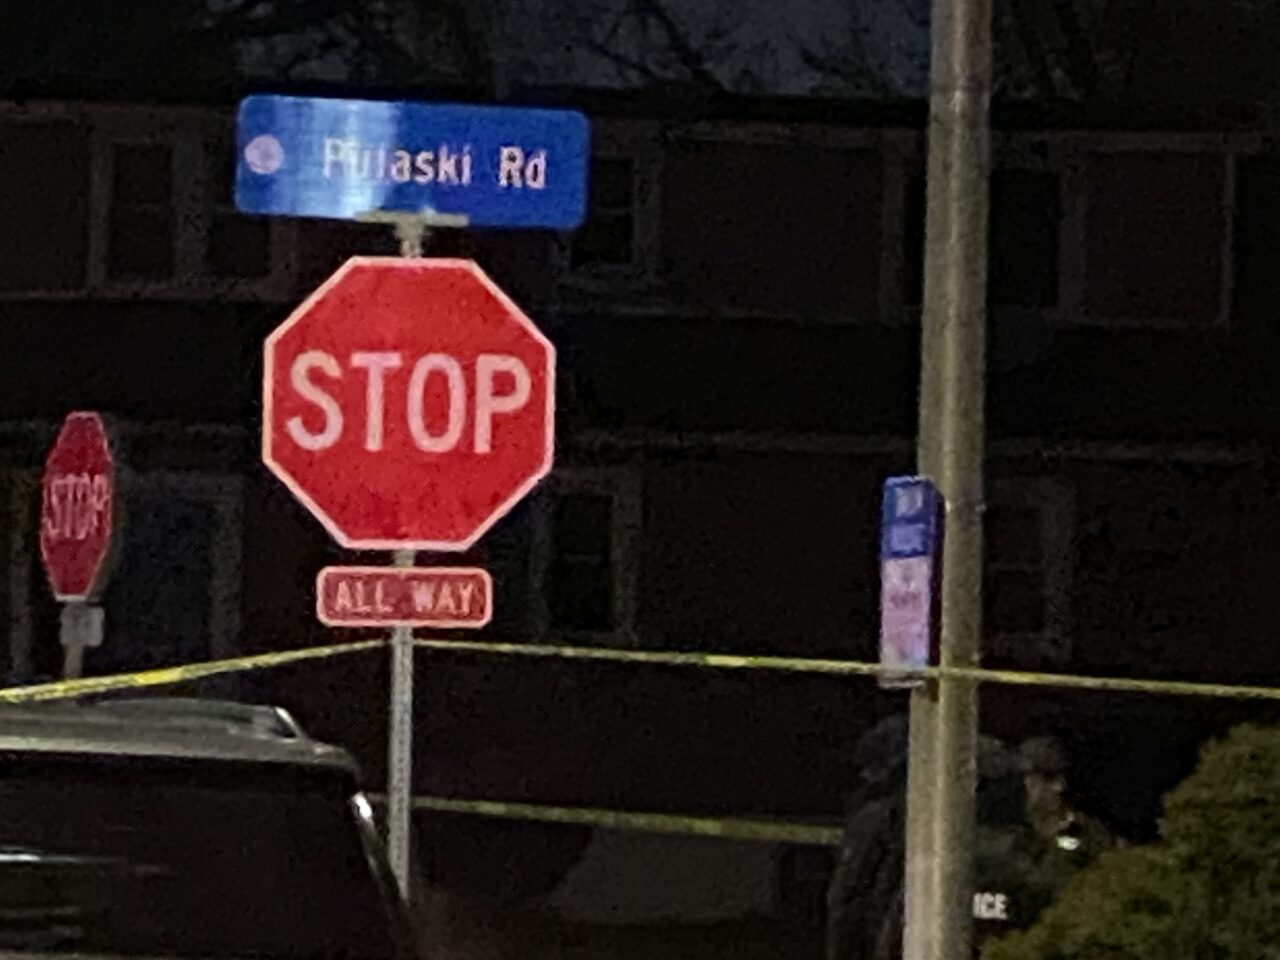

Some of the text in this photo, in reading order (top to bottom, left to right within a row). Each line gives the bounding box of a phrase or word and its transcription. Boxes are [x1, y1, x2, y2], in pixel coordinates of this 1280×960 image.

[322, 137, 547, 189] Pulaski Rd
[286, 349, 533, 454] STOP
[45, 472, 109, 541] STOP
[334, 579, 475, 615] ALL WAY
